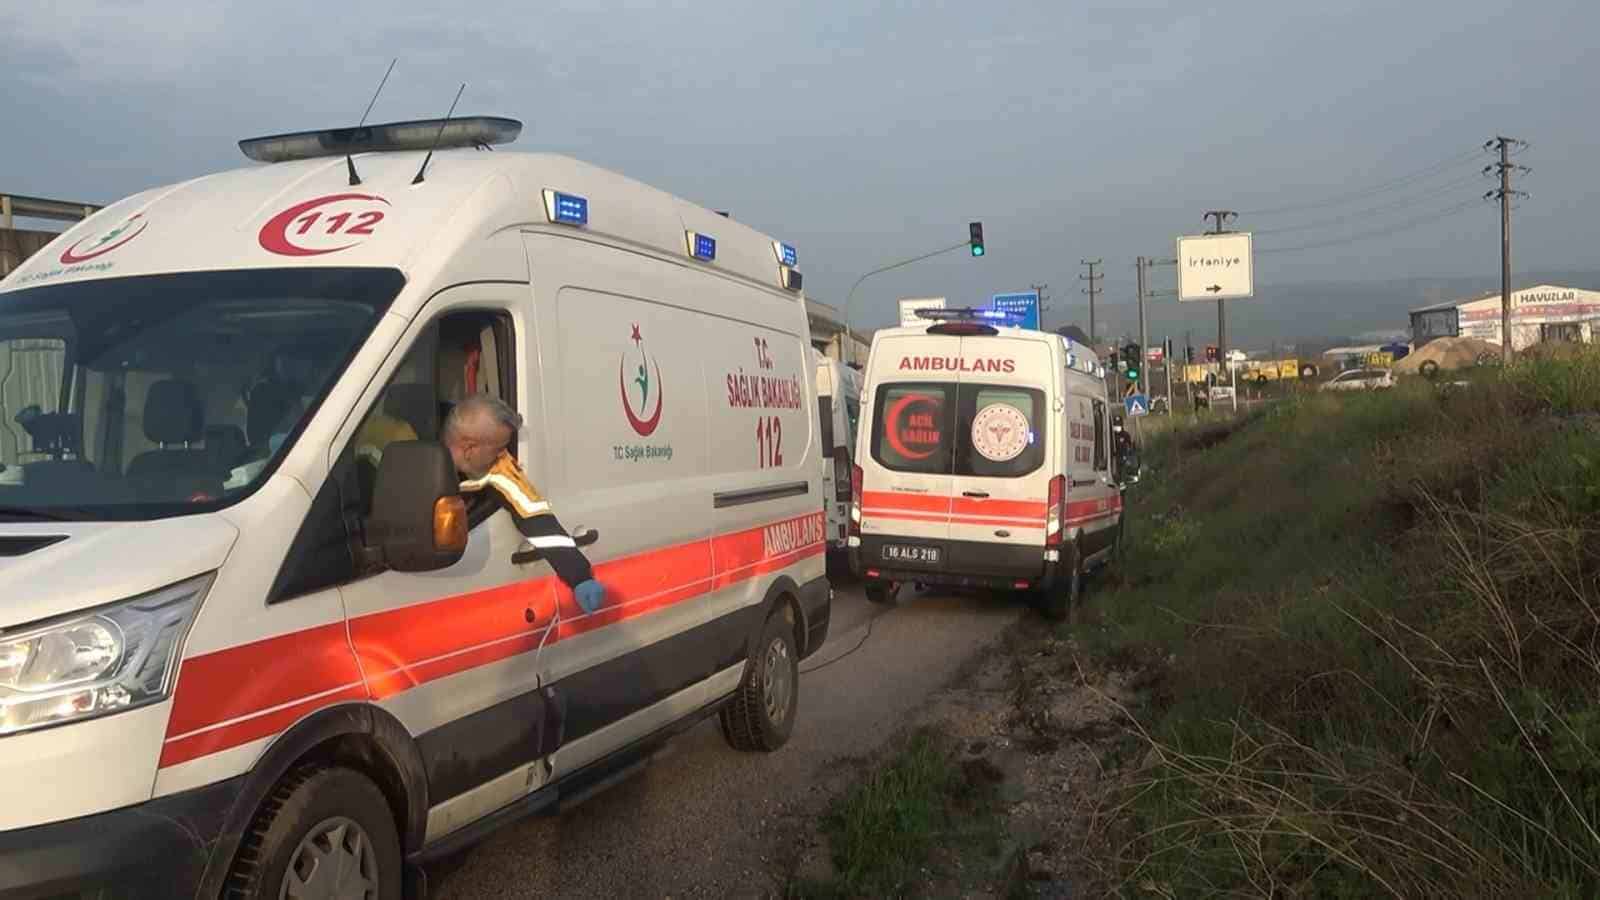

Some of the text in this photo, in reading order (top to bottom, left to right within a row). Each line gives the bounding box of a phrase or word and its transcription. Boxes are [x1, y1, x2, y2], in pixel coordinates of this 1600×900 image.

[296, 211, 384, 235] 112
[1520, 291, 1575, 303] HAVUZLAR
[898, 356, 1016, 373] AMBULANS
[727, 367, 761, 408] SAĞLIK
[757, 415, 783, 469] 112
[764, 514, 823, 557] AMBULANS
[901, 546, 918, 559] ALS
